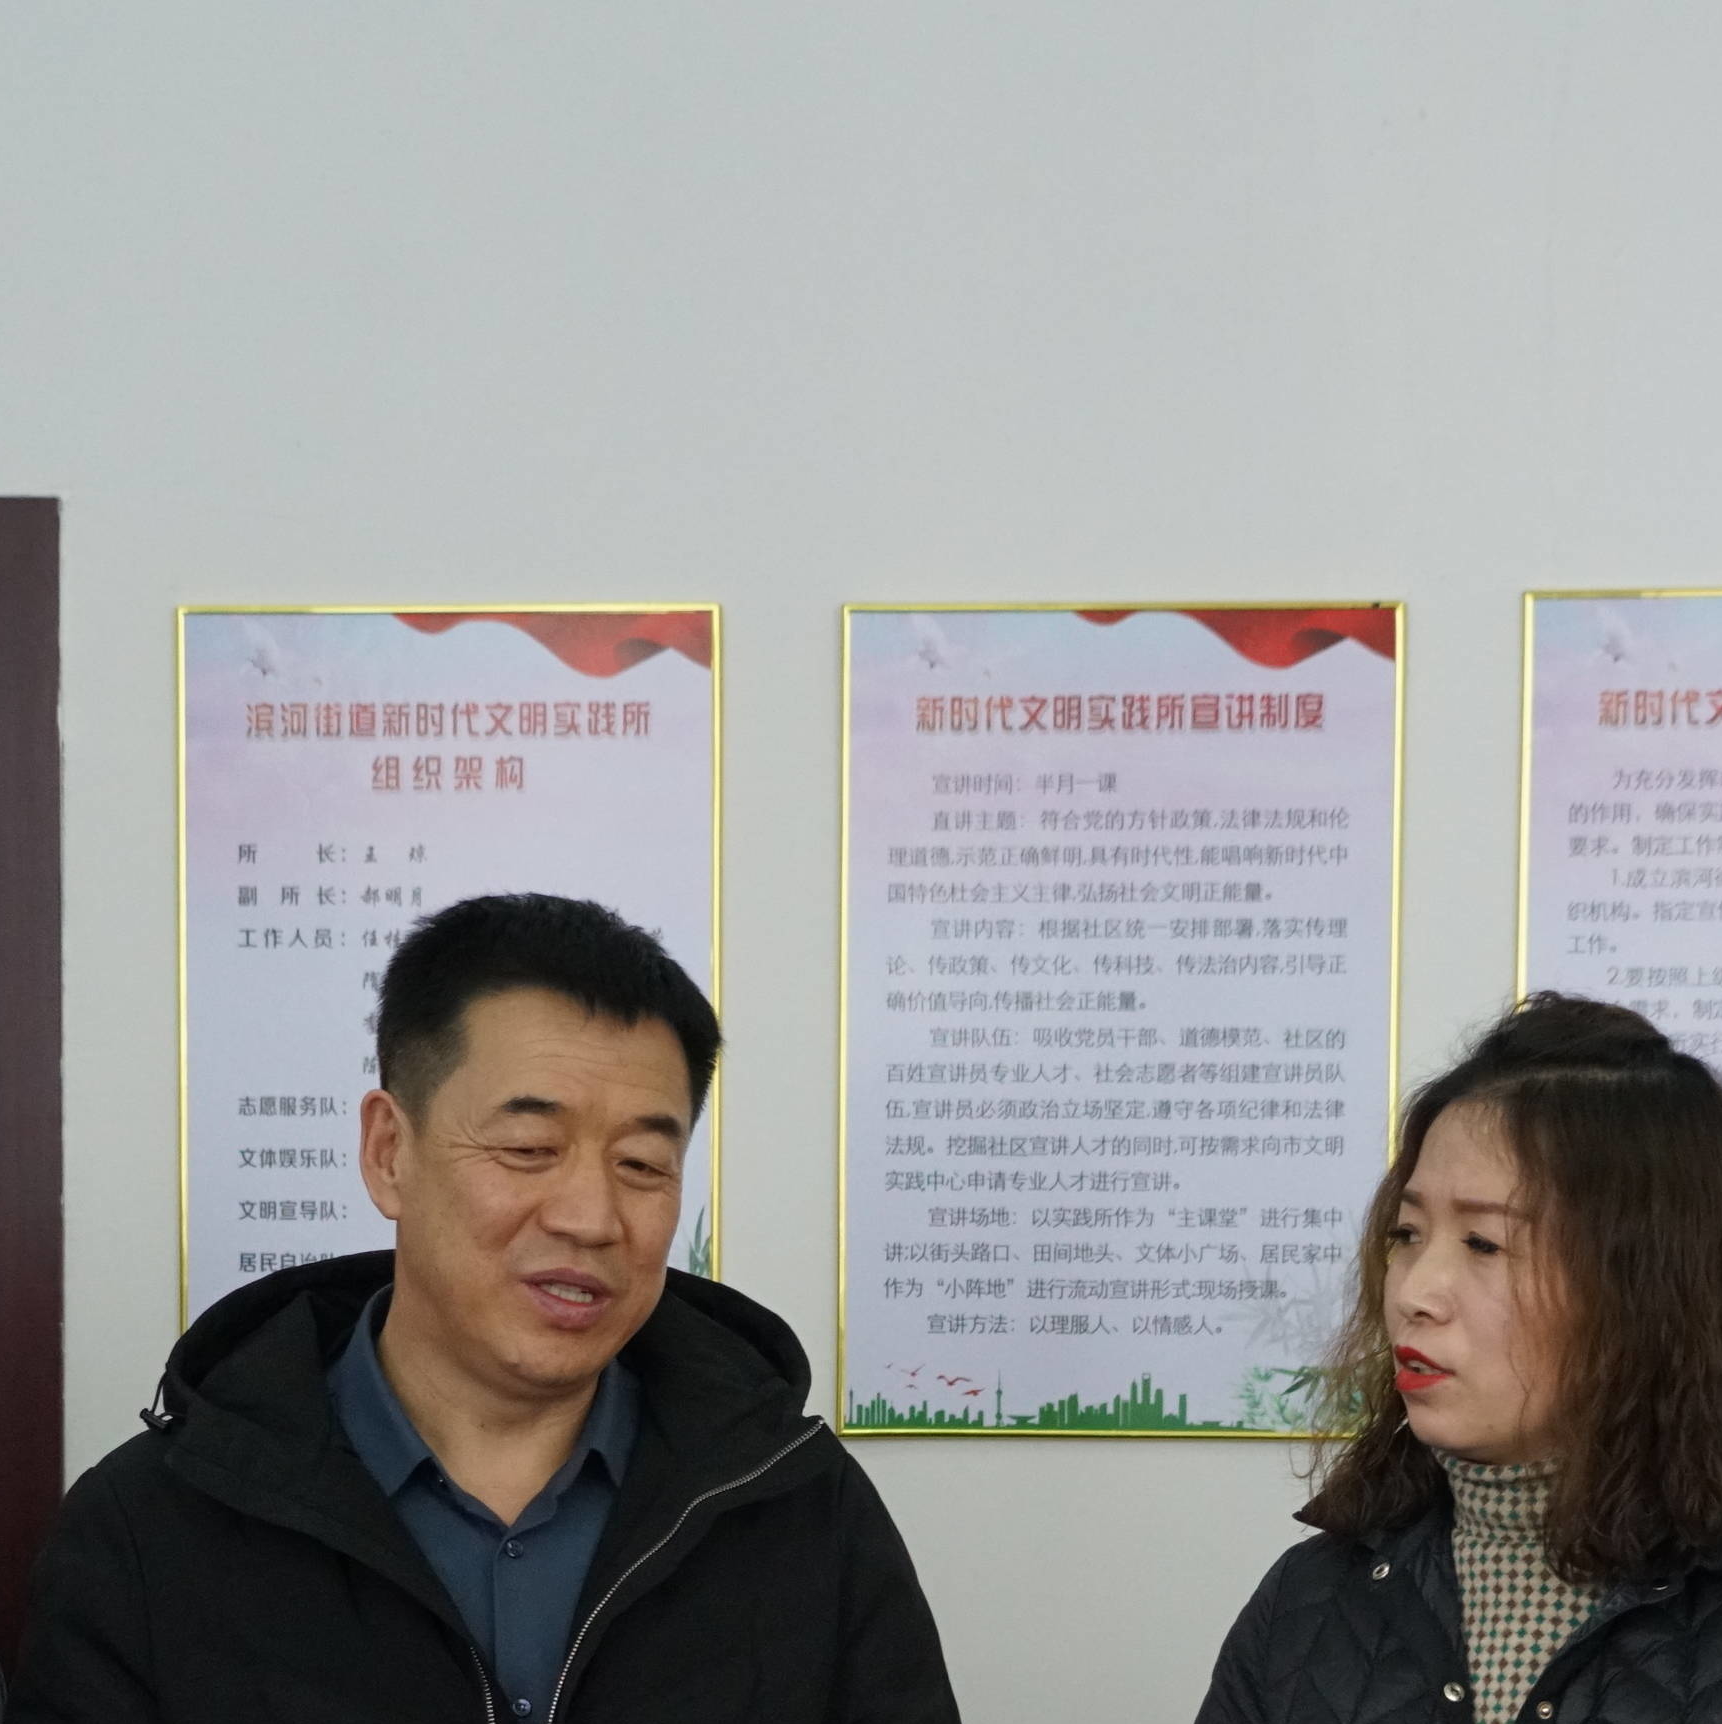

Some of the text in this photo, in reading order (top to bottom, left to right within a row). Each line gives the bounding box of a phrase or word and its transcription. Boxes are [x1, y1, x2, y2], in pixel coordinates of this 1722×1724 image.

[246, 701, 652, 739] 滨河街道新时代文明实践所
[916, 693, 1325, 732] 新时代文明实践所宣讲制度
[372, 755, 526, 792] 组织架构
[1567, 935, 1618, 955] 工作。
[238, 1096, 348, 1117] 志愿服务队：
[238, 1148, 348, 1169] 文体娱乐队：
[238, 1200, 348, 1221] 文明宣导队：
